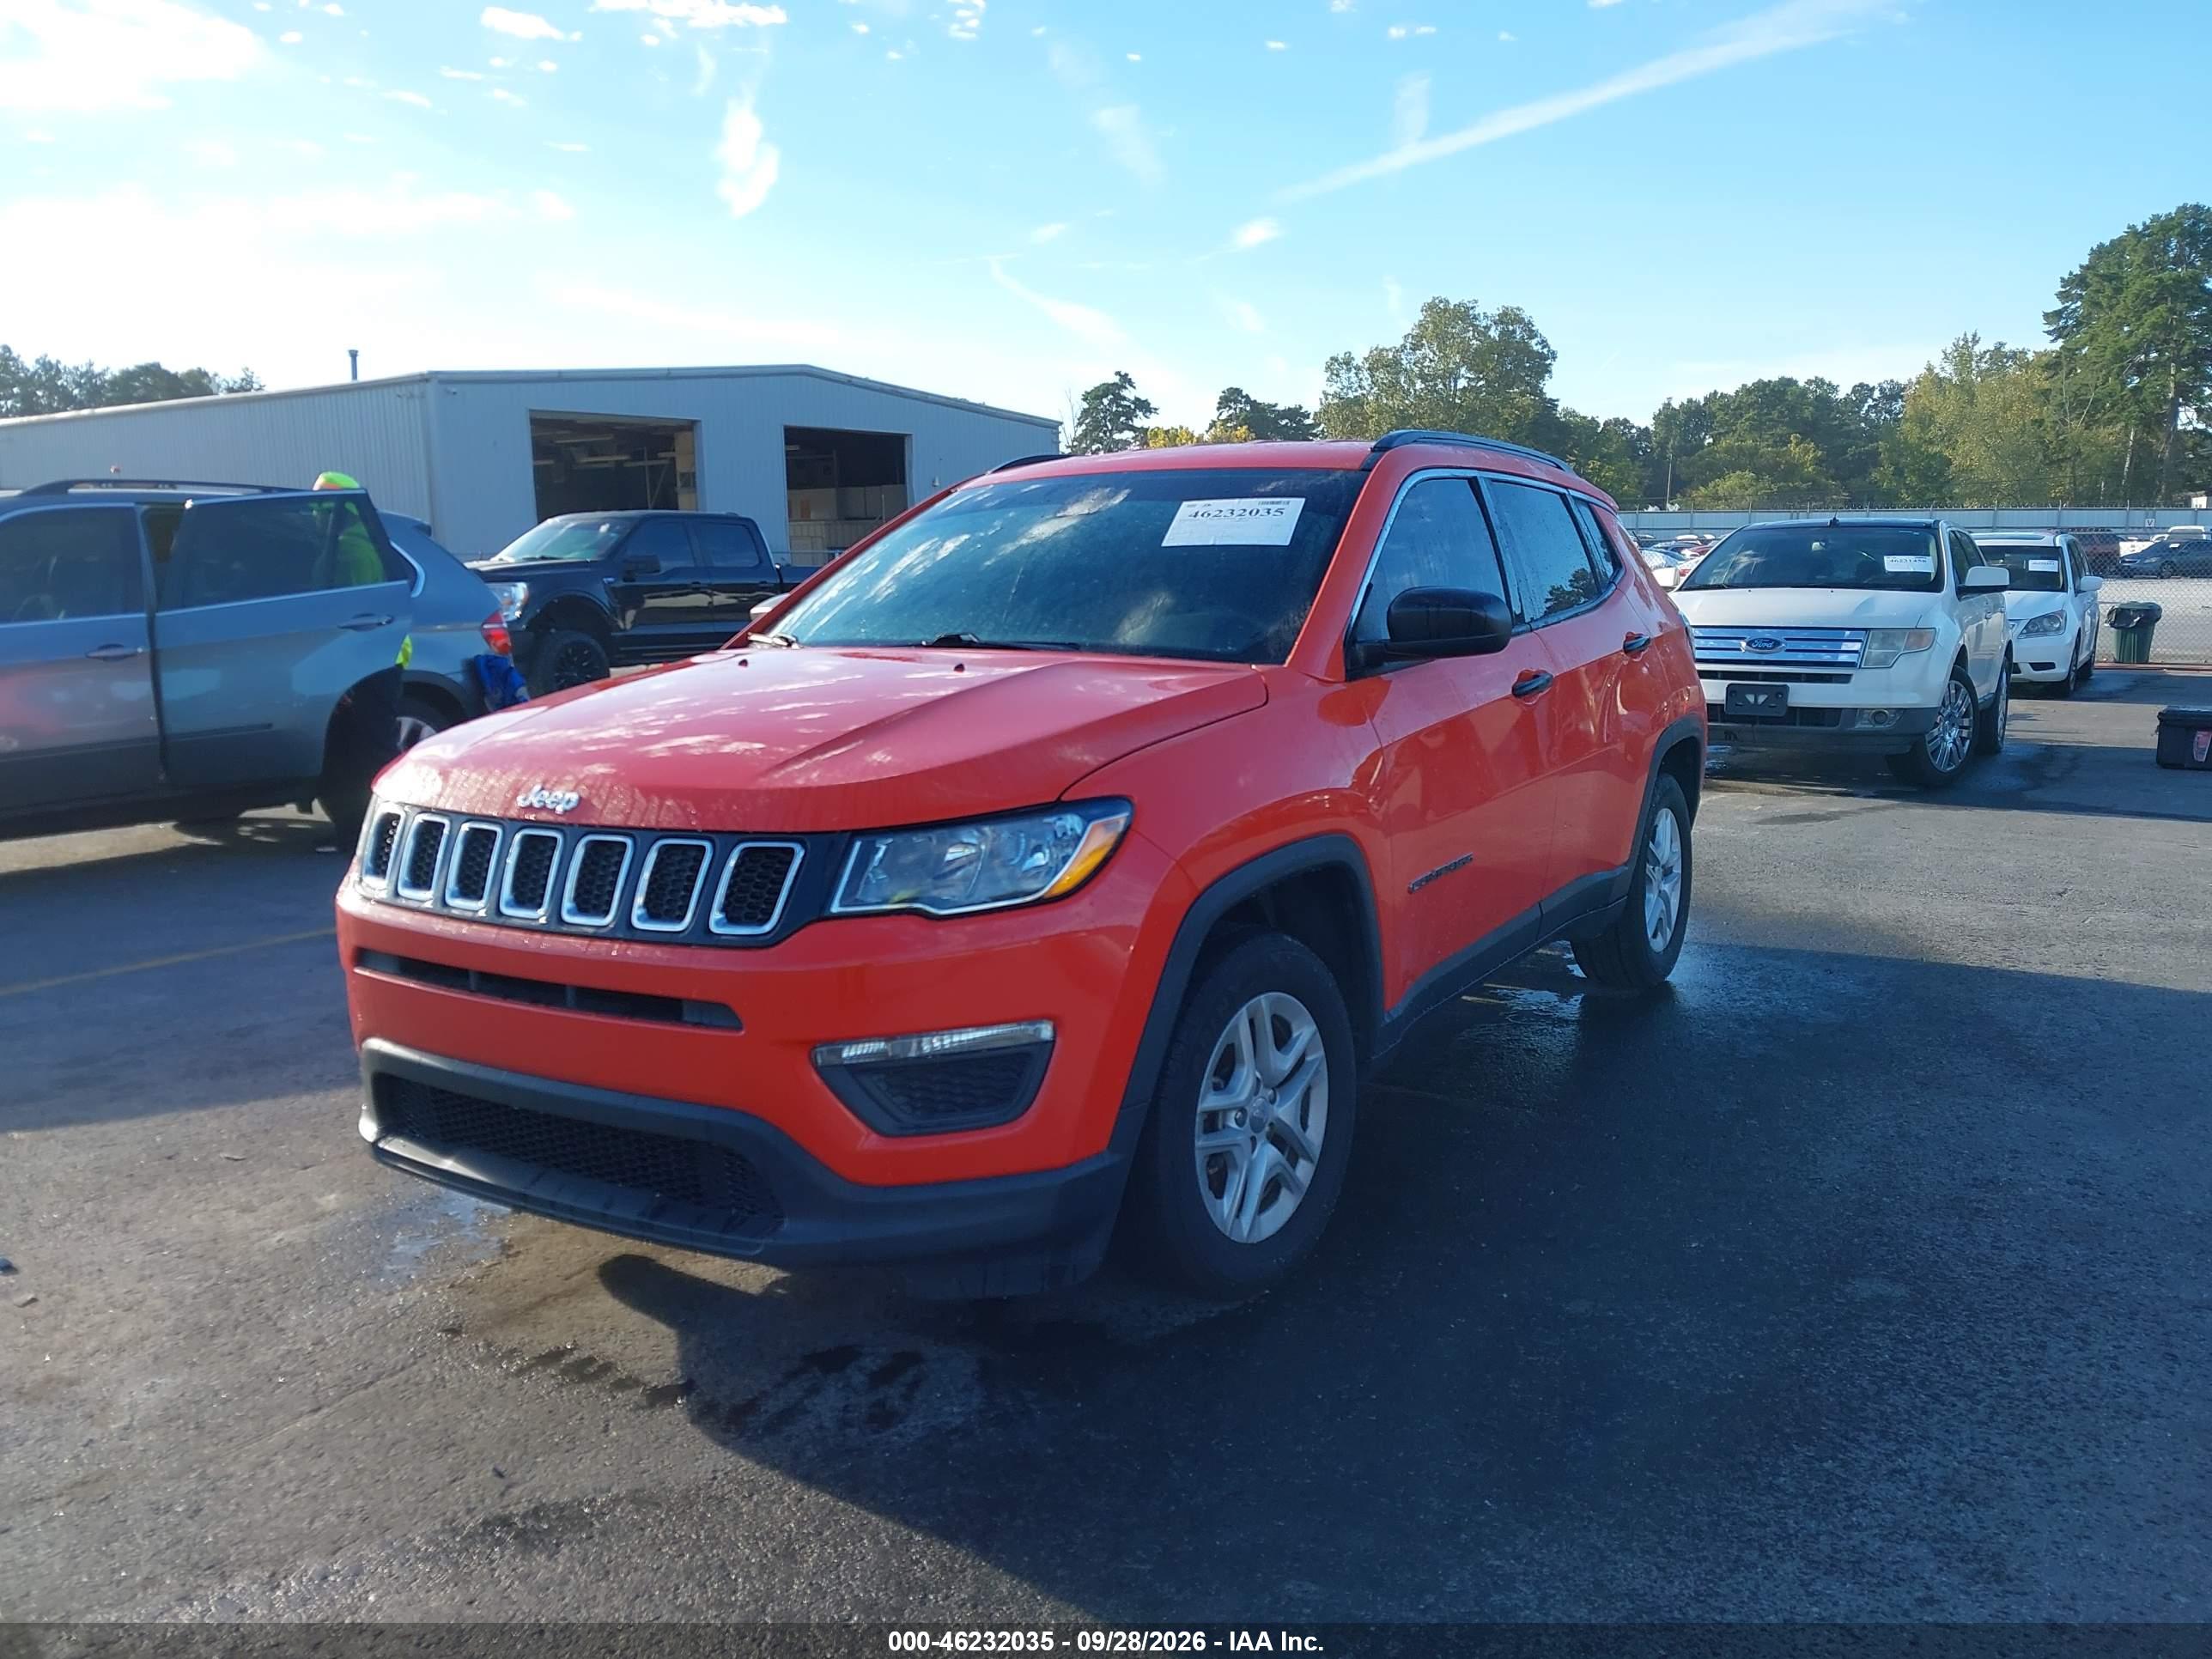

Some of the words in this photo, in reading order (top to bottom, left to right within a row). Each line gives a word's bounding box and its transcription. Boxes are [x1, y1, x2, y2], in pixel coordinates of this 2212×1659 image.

[1188, 507, 1285, 520] 46232035
[1751, 638, 1774, 648] Ford
[516, 783, 580, 815] Jeep
